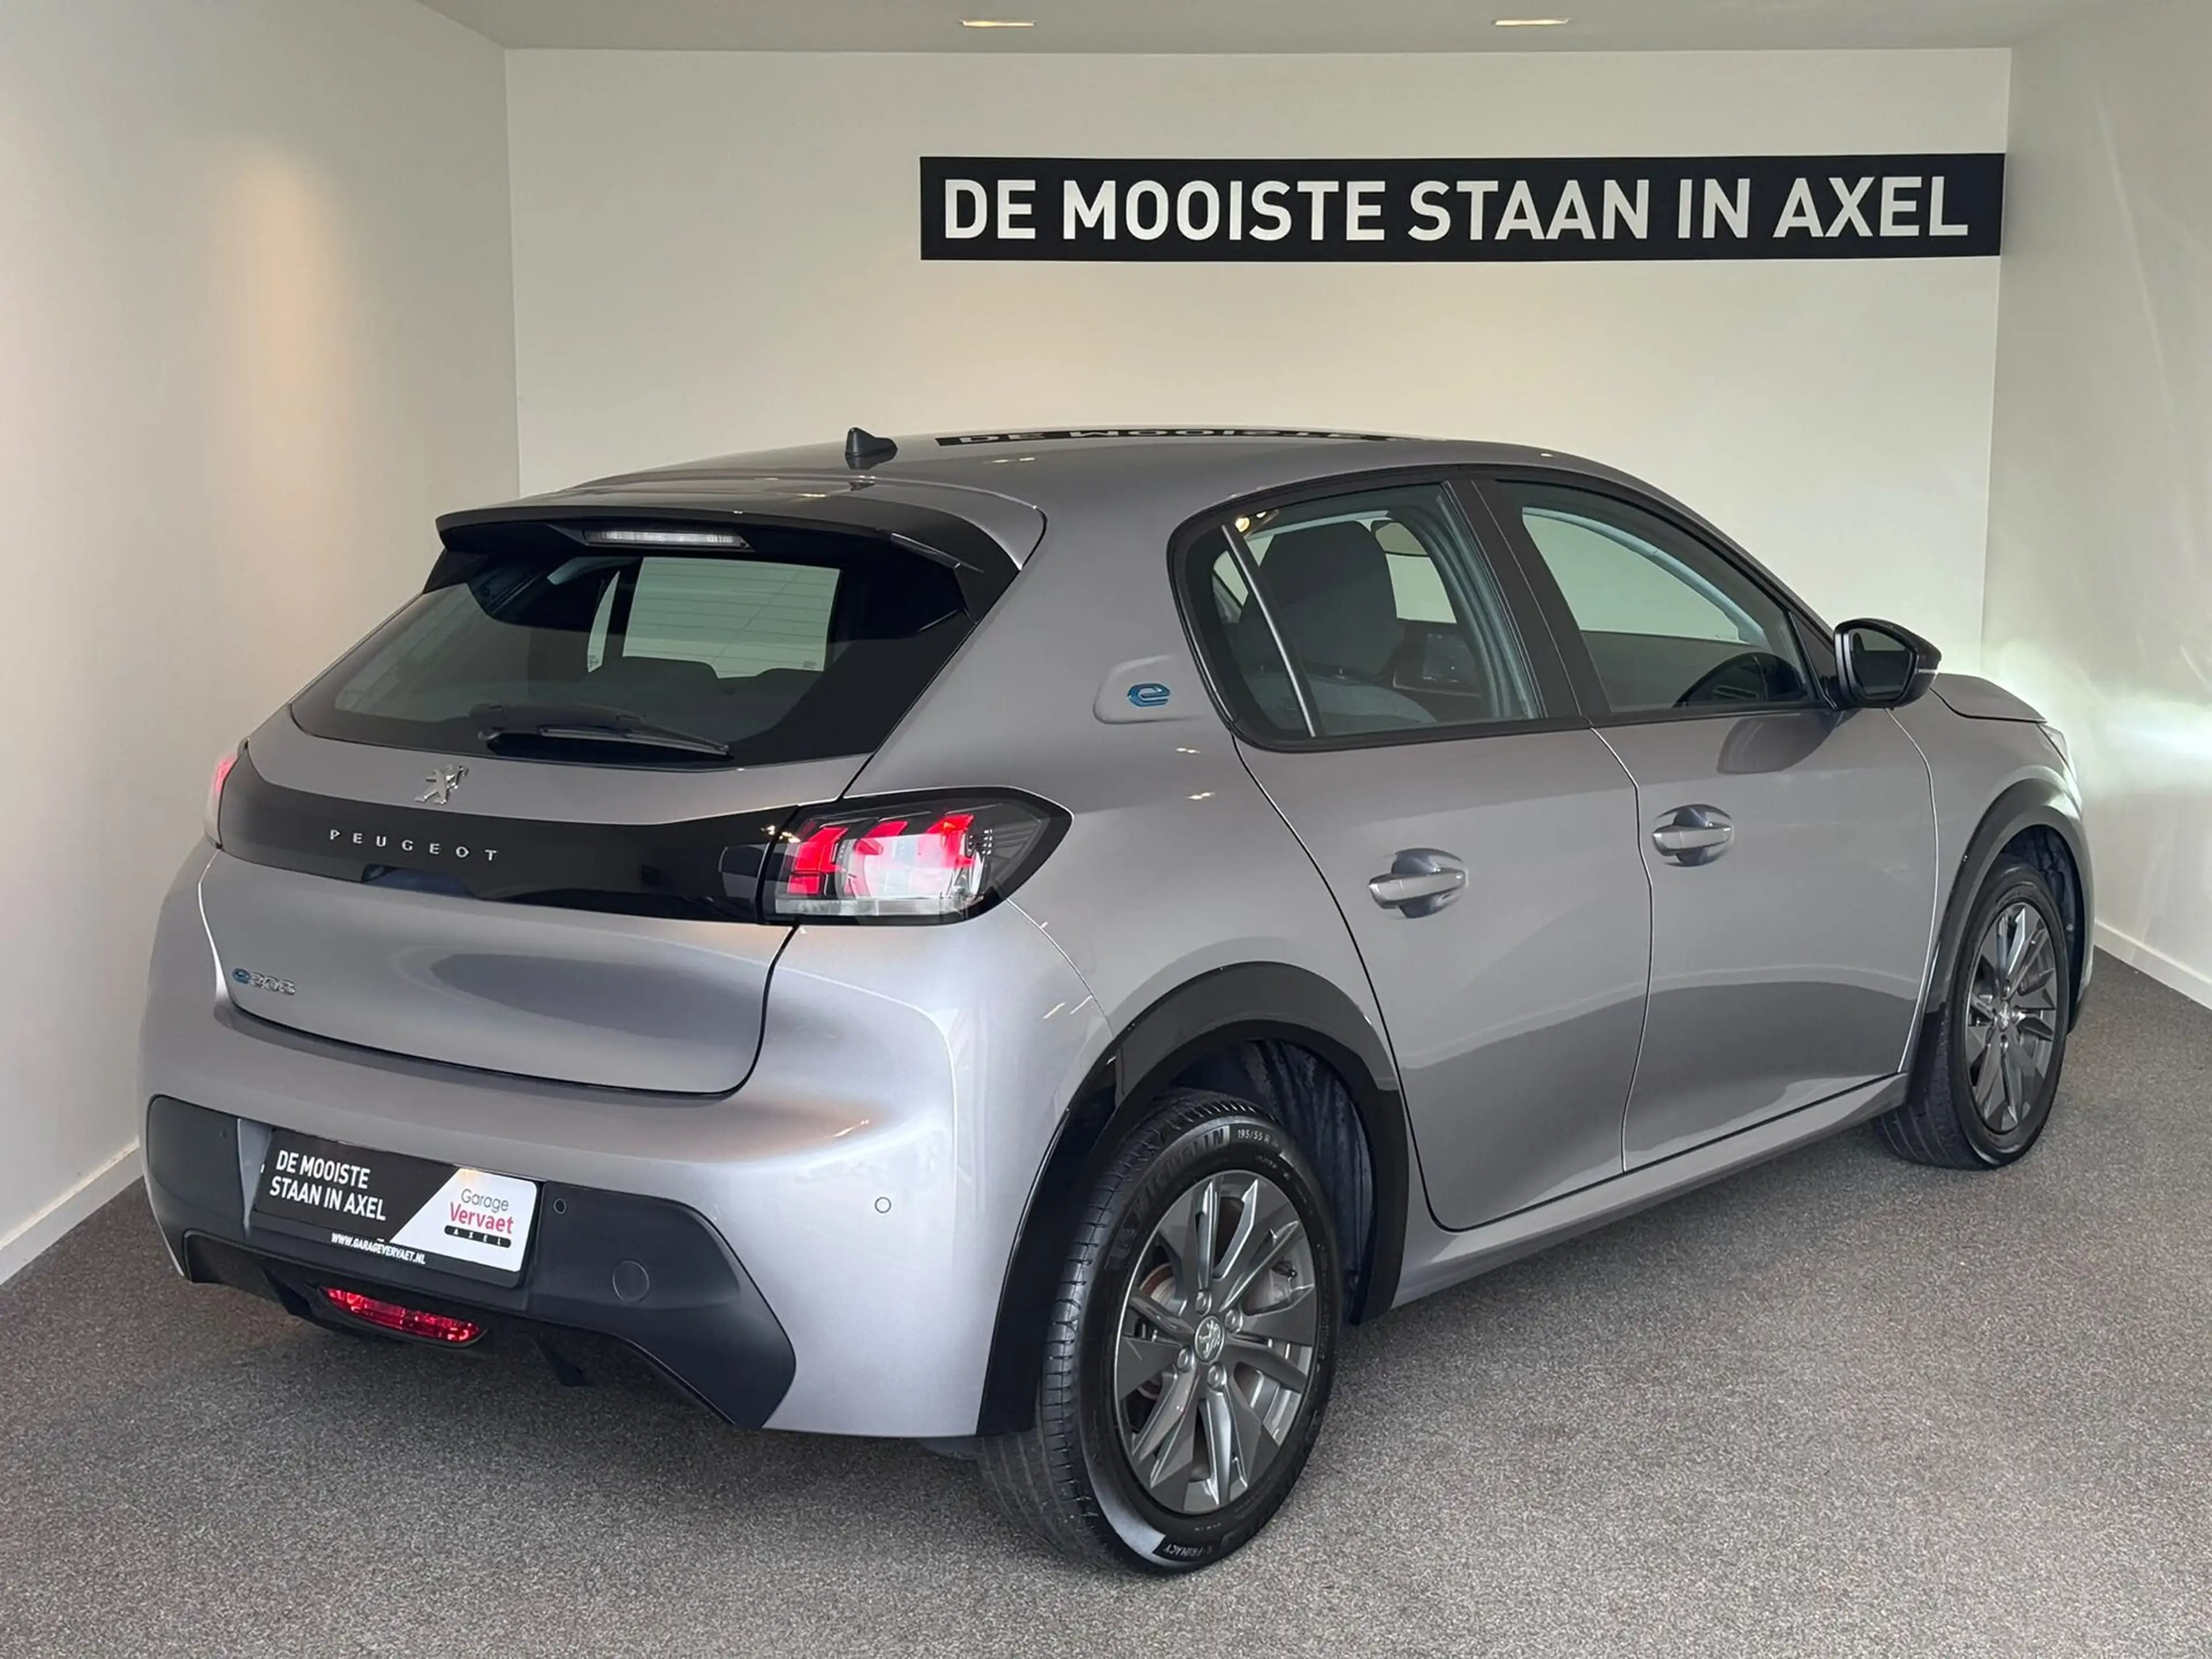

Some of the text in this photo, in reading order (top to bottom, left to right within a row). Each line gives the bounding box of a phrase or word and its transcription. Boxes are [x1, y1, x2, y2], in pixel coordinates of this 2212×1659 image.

[945, 176, 1968, 241] DE MOOISTE STAAN IN AXEL
[329, 829, 499, 862] PEUGEOT
[1238, 1129, 1263, 1141] 195/55
[275, 1149, 371, 1190] DE MOOISTE
[269, 1175, 387, 1221] STAAN IN AXEL
[461, 1188, 509, 1214] Garage
[450, 1201, 514, 1234] Vervaet
[331, 1232, 426, 1265] WWW.GARAGEVERVAET.NL
[453, 1228, 502, 1245] AXEL
